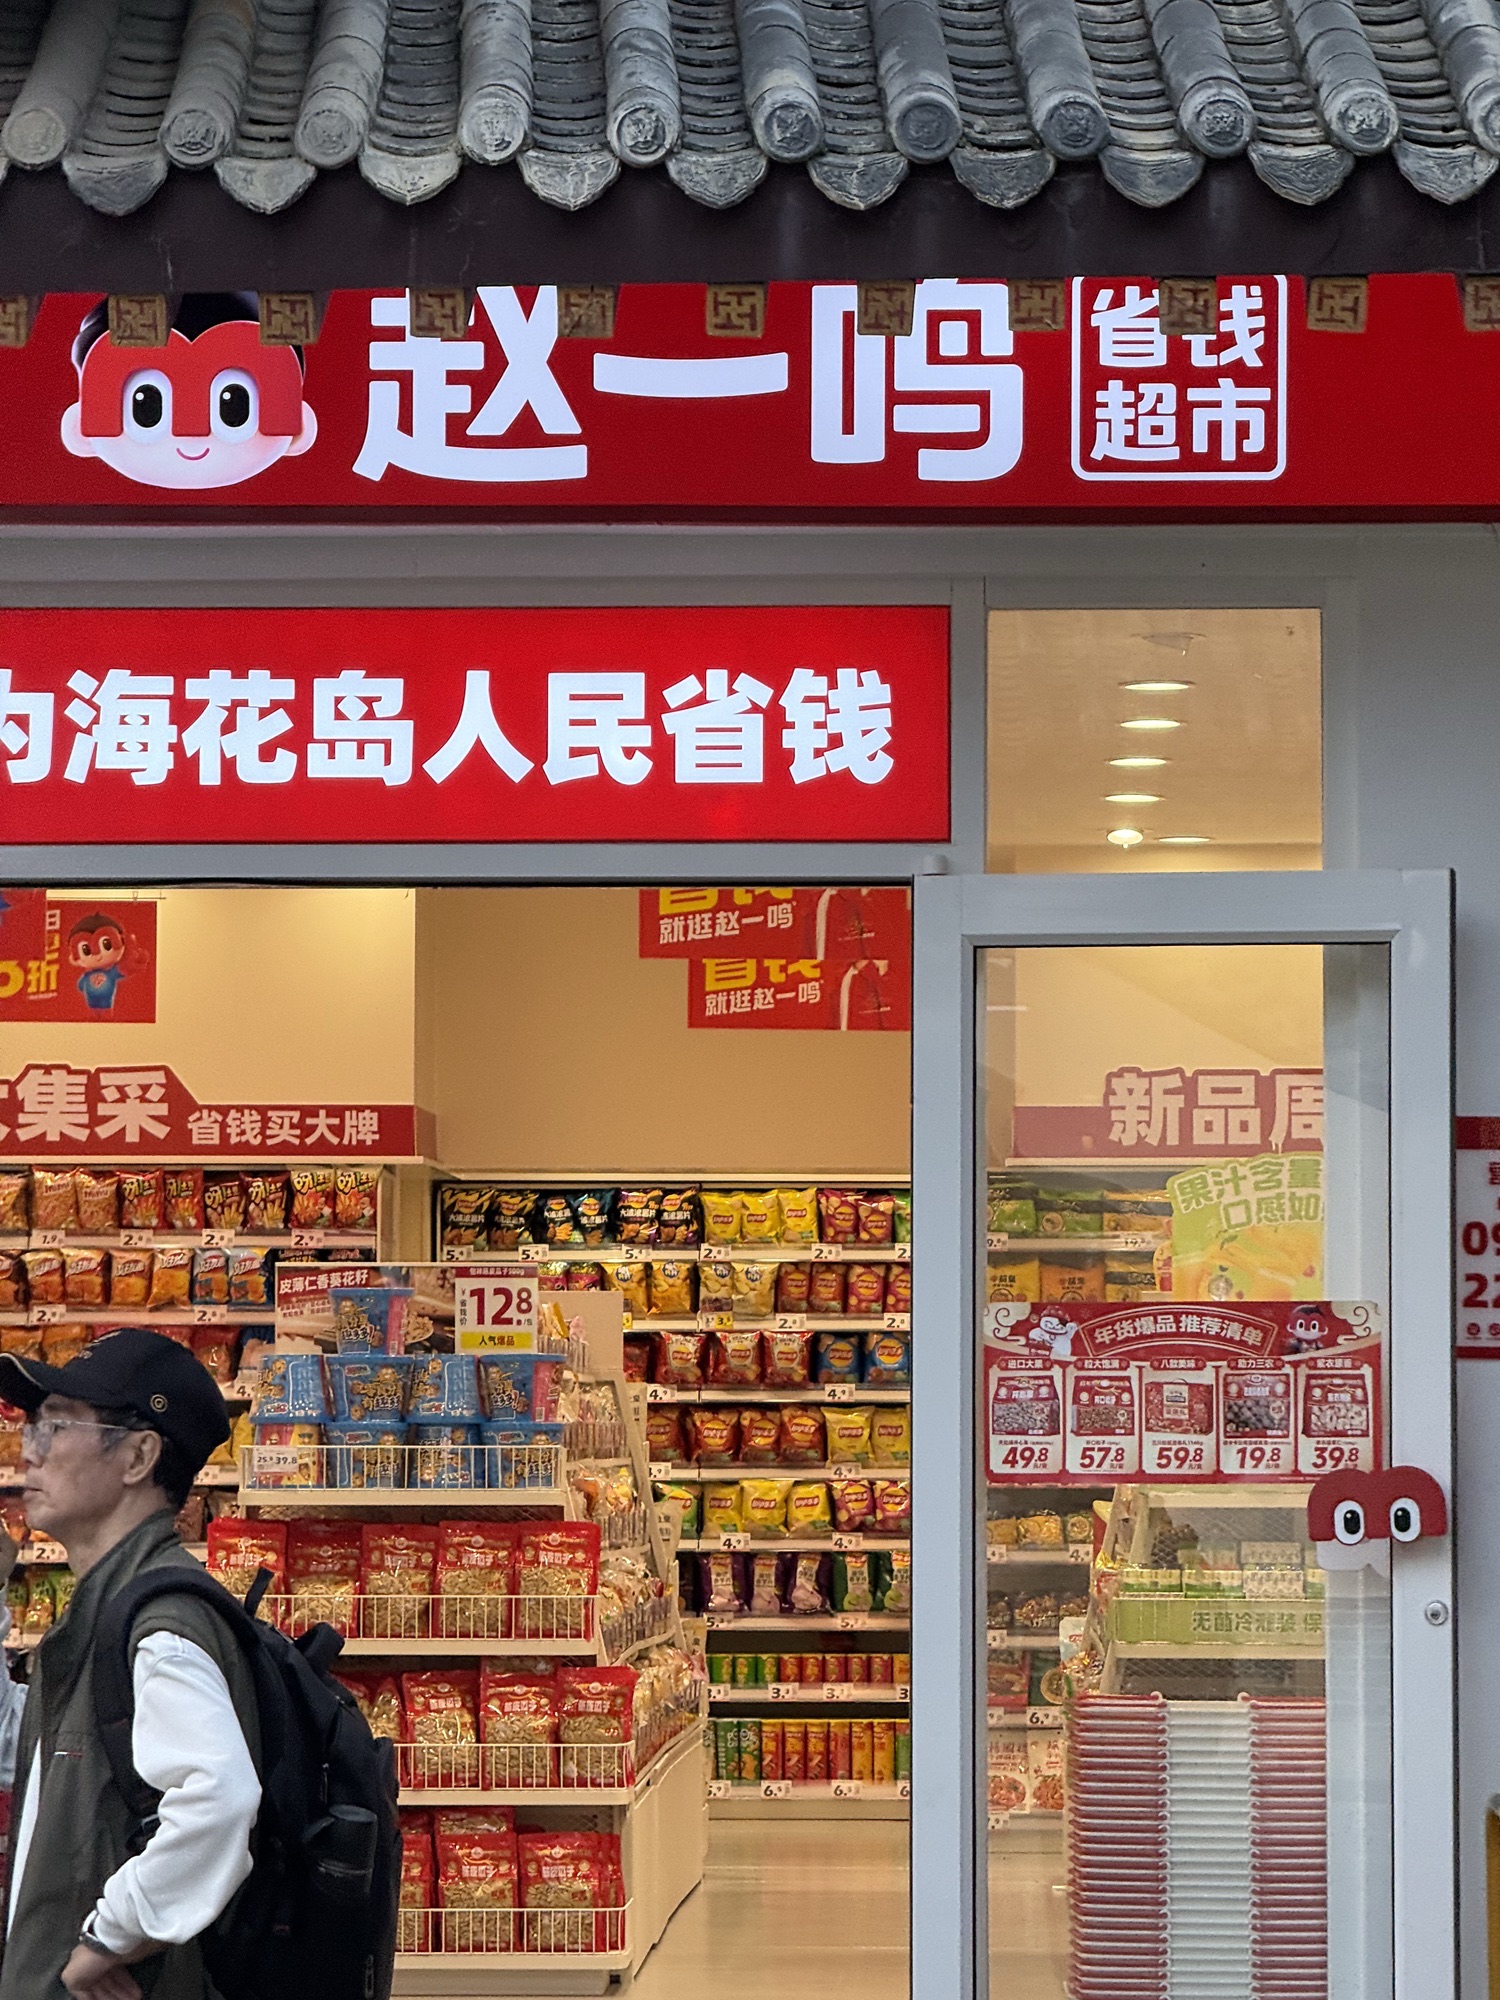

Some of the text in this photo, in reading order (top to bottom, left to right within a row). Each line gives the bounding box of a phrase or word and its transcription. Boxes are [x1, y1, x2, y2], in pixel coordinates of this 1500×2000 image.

[1091, 285, 1266, 369] 省钱
[353, 278, 1025, 482] 赵一鸣
[1091, 379, 1271, 462] 超市
[0, 668, 894, 787] 为海花岛人民省钱
[660, 903, 794, 944] 就逛赵一鸣
[705, 981, 821, 1016] 就逛赵一鸣
[1109, 1073, 1323, 1147] 新品周
[187, 1109, 381, 1146] 省钱买大牌
[1175, 1156, 1322, 1213] 果汁含量
[279, 1270, 369, 1294] 皮薄仁香葵花籽
[469, 1287, 532, 1326] 12.8
[479, 1335, 515, 1346] 人气爆品
[1093, 1314, 1265, 1347] 年货爆品 推荐清单
[1008, 1359, 1043, 1369] 进口大果
[1084, 1359, 1120, 1369] 粒大饱满
[1237, 1358, 1275, 1369] 助力三农
[1003, 1447, 1049, 1468] 49.8
[1079, 1447, 1125, 1469] 57.8
[1156, 1447, 1204, 1469] 59.8
[1236, 1447, 1281, 1469] 19.8
[1311, 1447, 1359, 1469] 39.8
[1029, 1712, 1050, 1725] 6.9
